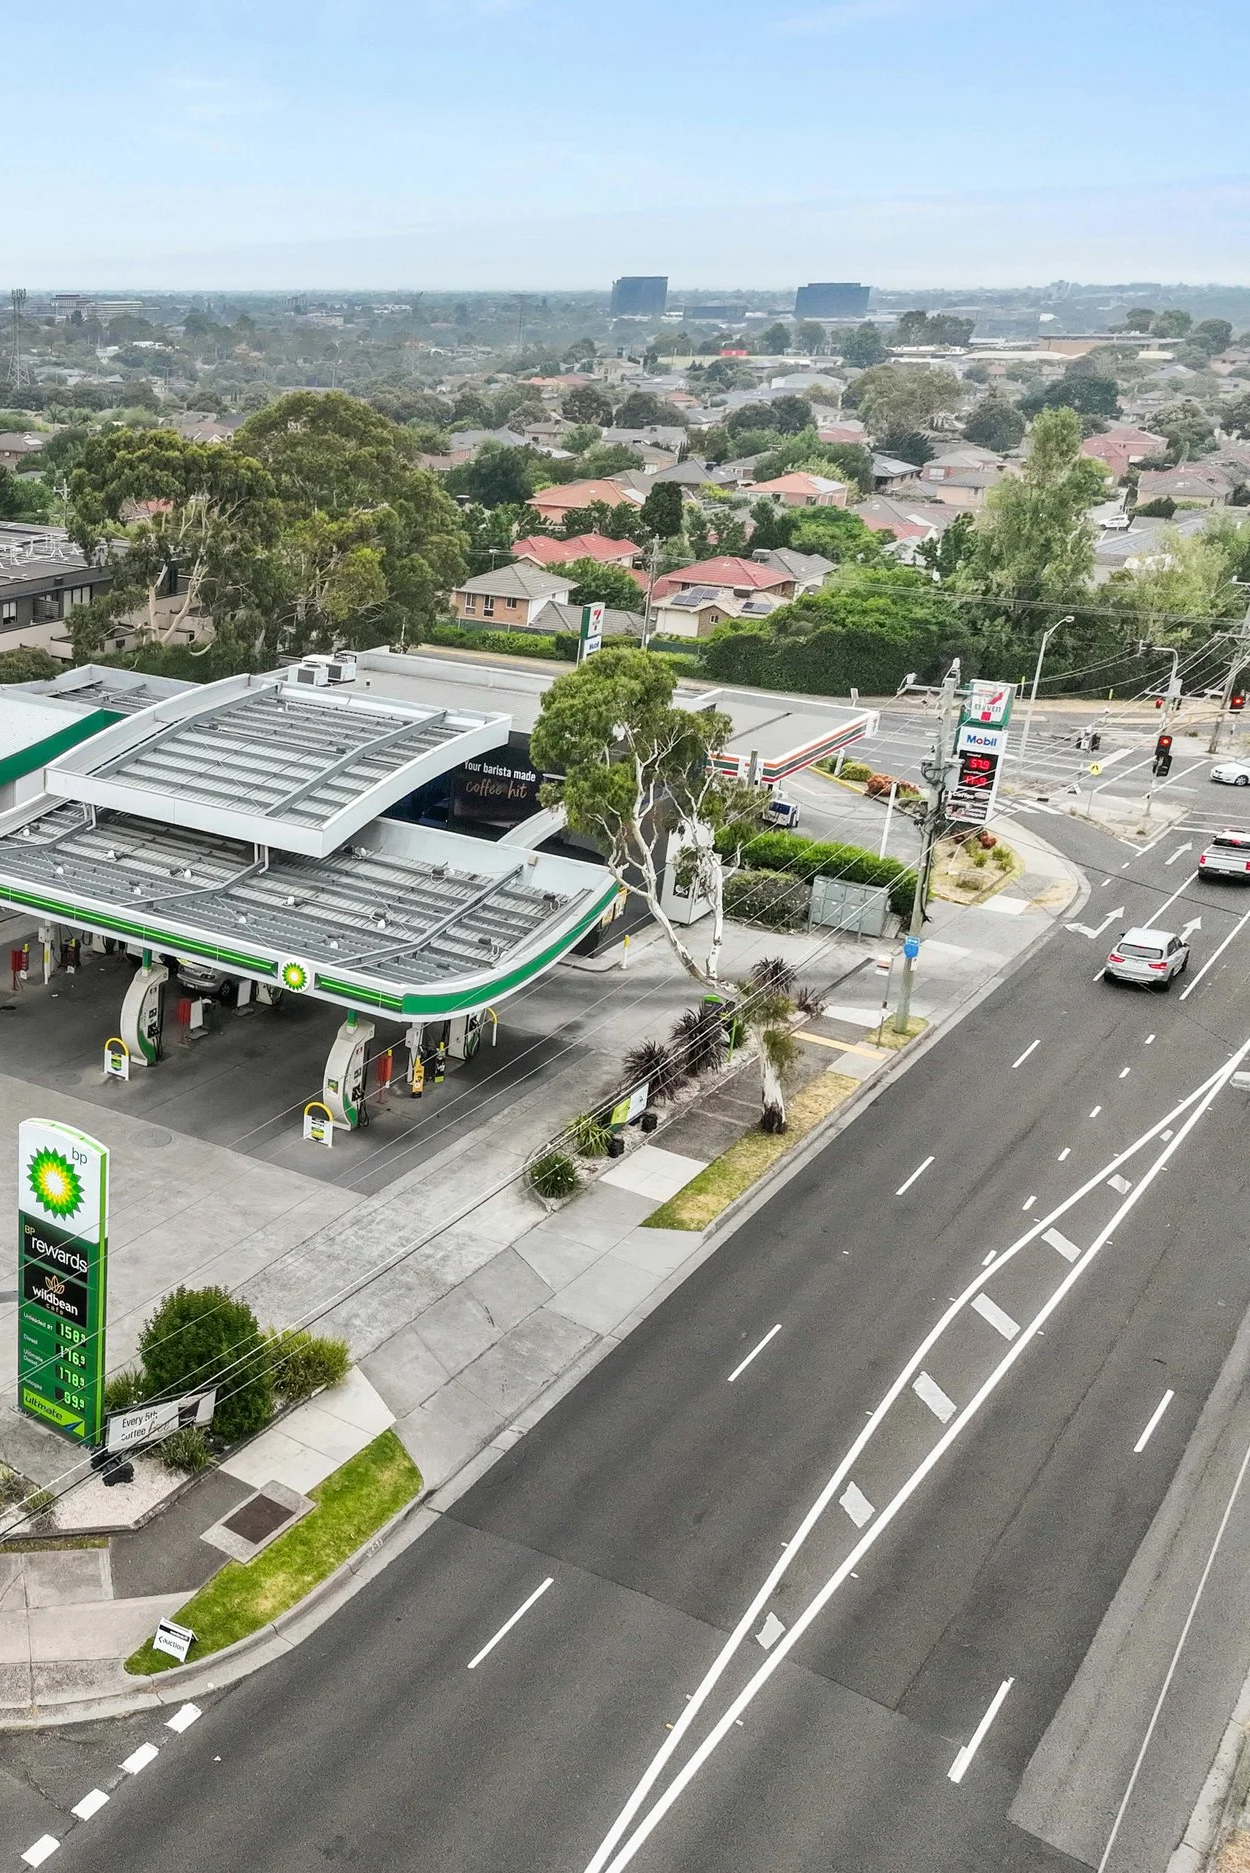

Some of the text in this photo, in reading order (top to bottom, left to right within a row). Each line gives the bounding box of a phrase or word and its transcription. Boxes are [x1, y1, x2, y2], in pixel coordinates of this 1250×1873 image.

[966, 734, 997, 747] Mobil
[464, 760, 536, 782] Your barista made
[465, 778, 527, 799] coffee hit
[72, 1147, 88, 1165] bp
[24, 1224, 36, 1235] BP
[31, 1236, 88, 1273] rewards
[32, 1285, 78, 1316] wildbean
[60, 1323, 86, 1343] 1589
[25, 1395, 63, 1420] ultimate
[122, 1415, 144, 1428] Every
[162, 1638, 185, 1652] auction
